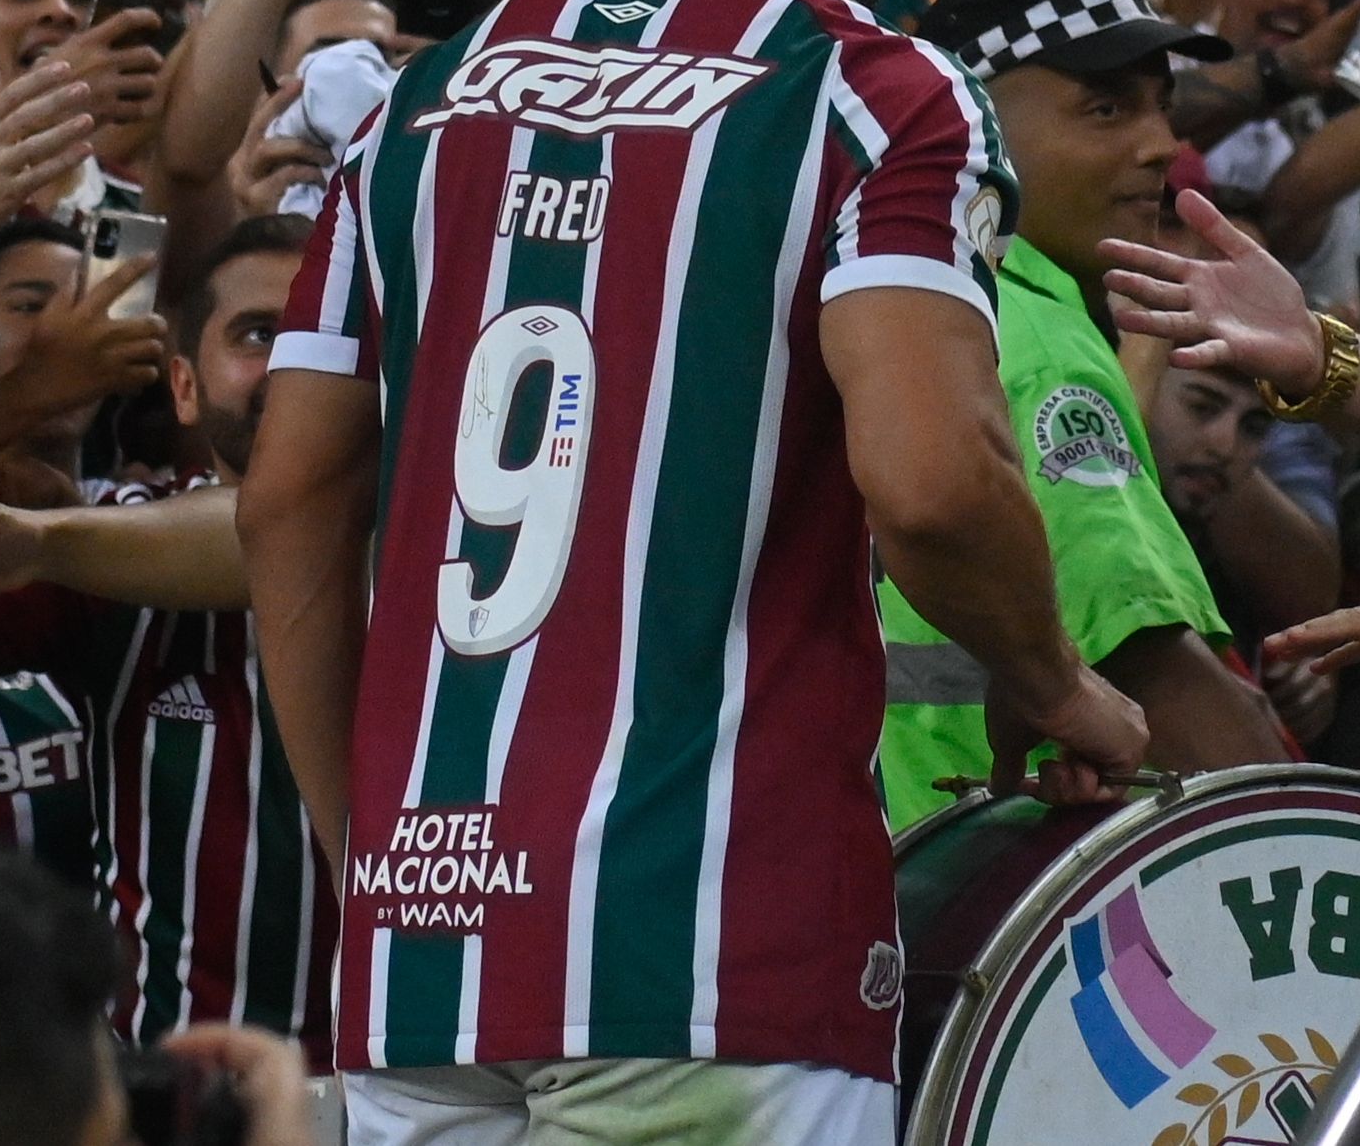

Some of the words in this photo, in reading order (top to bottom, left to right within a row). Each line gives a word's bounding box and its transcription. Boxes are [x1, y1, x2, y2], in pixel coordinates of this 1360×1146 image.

[497, 171, 612, 243] FRED
[555, 374, 582, 432] TIM
[1036, 395, 1063, 451] EMPRESA
[1061, 388, 1126, 445] CERTIFICADA
[1058, 409, 1106, 438] ISO
[437, 306, 596, 656] 9
[147, 702, 215, 722] adidas
[389, 812, 494, 852] HOTEL
[353, 851, 533, 896] NACIONAL
[377, 907, 394, 920] BY
[400, 902, 485, 928] WAM
